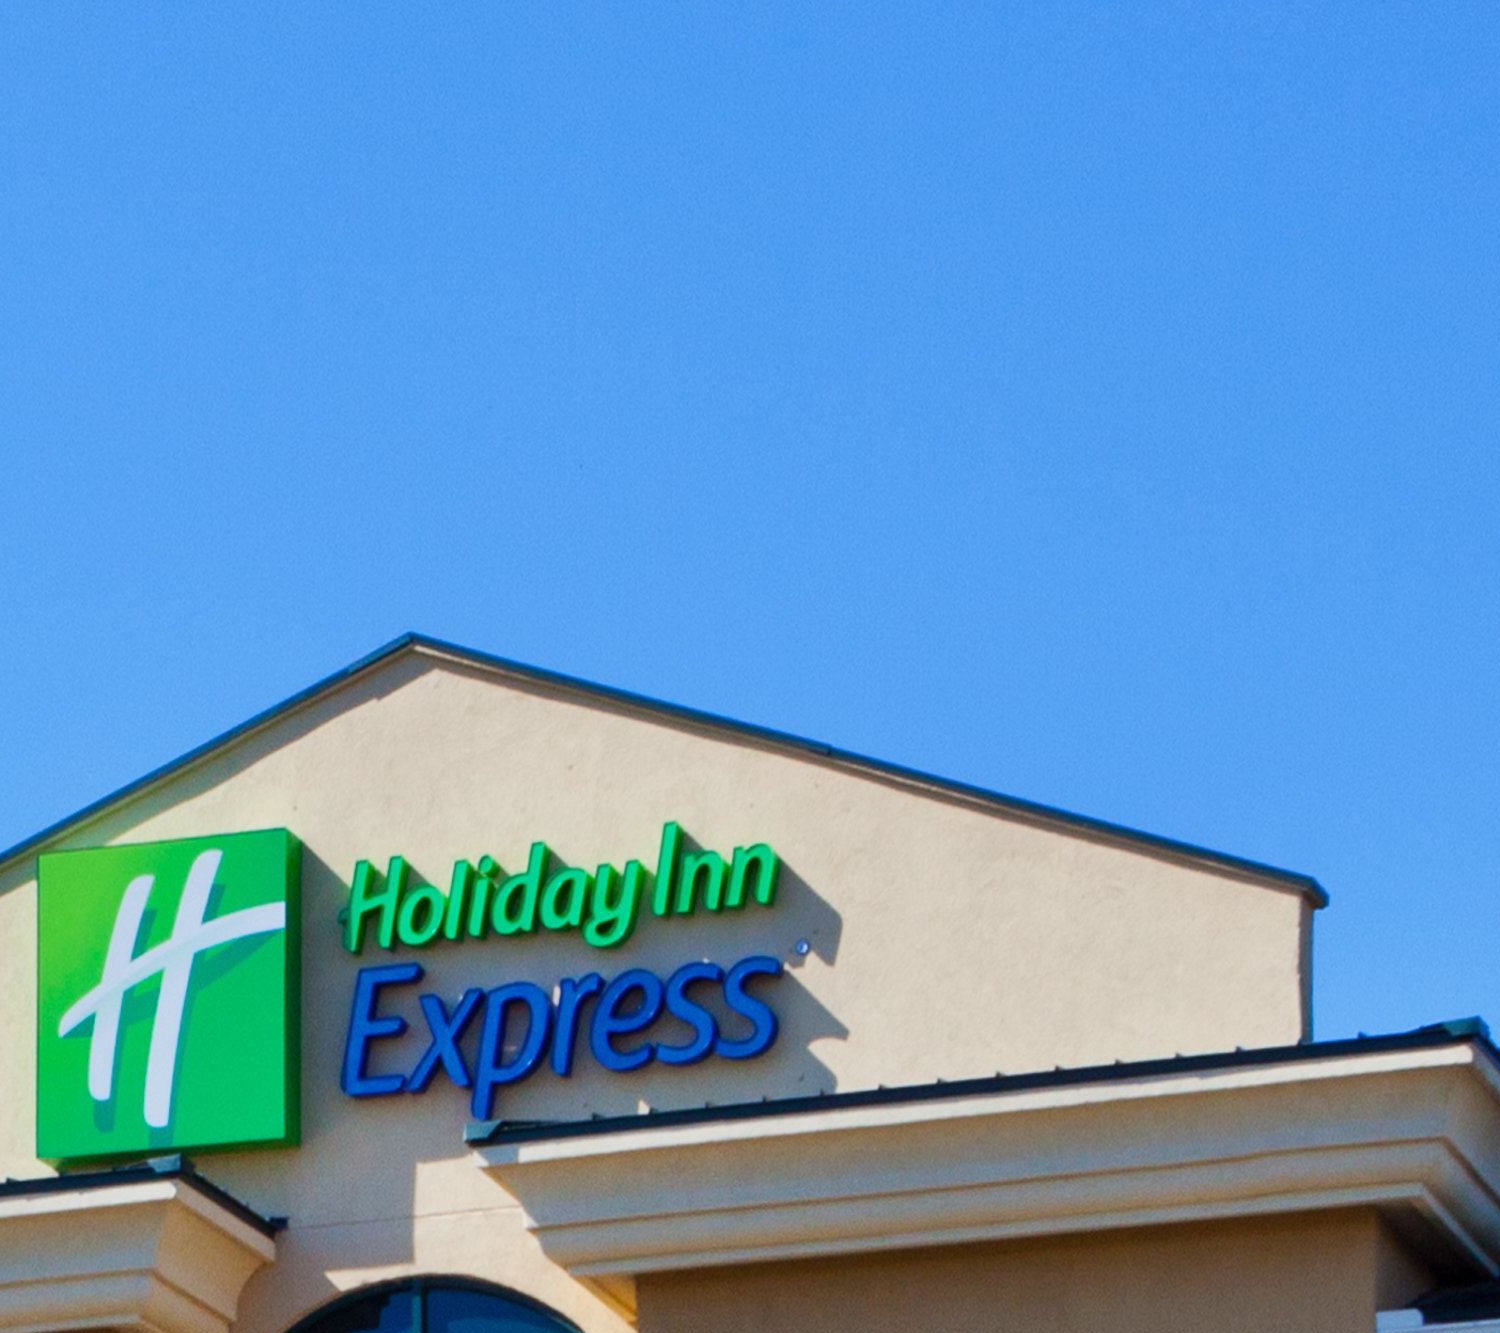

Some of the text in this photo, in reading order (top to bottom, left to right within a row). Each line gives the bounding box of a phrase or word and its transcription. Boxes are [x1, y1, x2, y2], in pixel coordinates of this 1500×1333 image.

[342, 820, 782, 954] Holiday Inn
[340, 955, 783, 1121] Express
